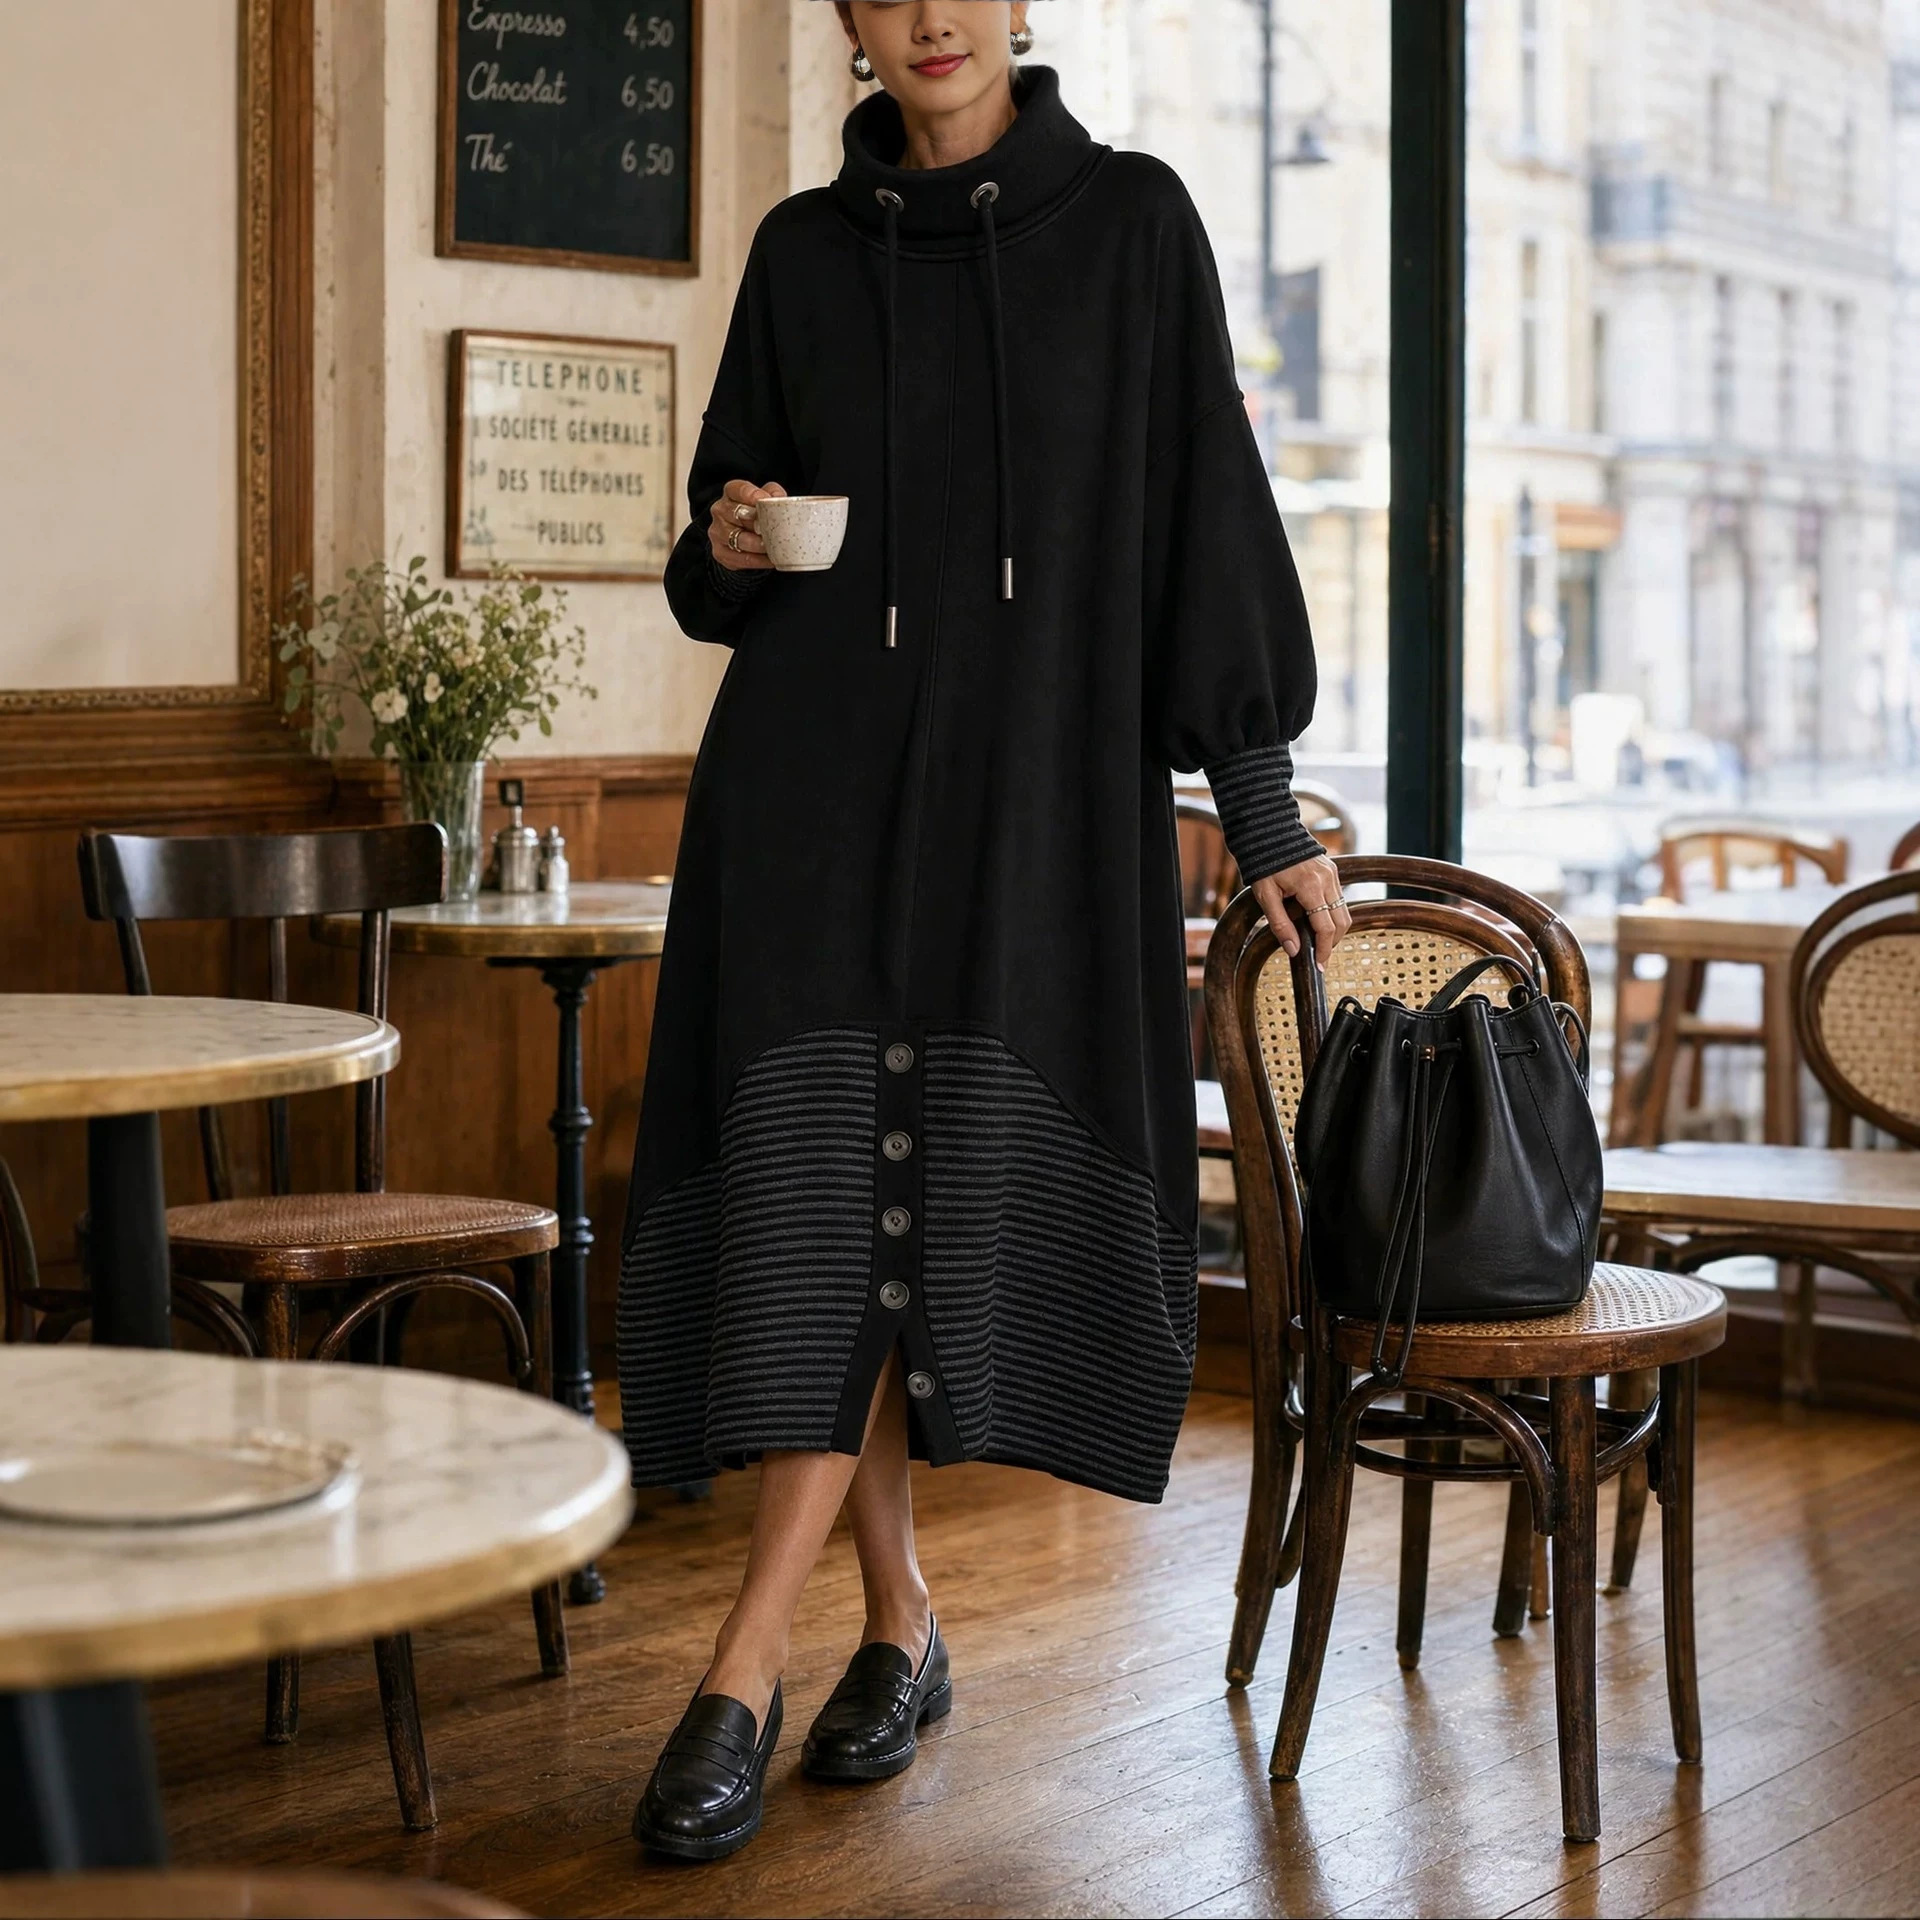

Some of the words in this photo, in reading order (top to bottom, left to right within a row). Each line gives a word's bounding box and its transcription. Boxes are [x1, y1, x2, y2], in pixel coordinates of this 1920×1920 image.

[467, 0, 567, 49] Expresso
[623, 13, 675, 49] 4,50
[466, 61, 568, 105] Chocolat
[621, 74, 675, 113] 6,50
[465, 132, 514, 173] Thé
[621, 139, 675, 177] 6,50
[498, 468, 529, 491] DES
[538, 521, 605, 545] PUBLICS
